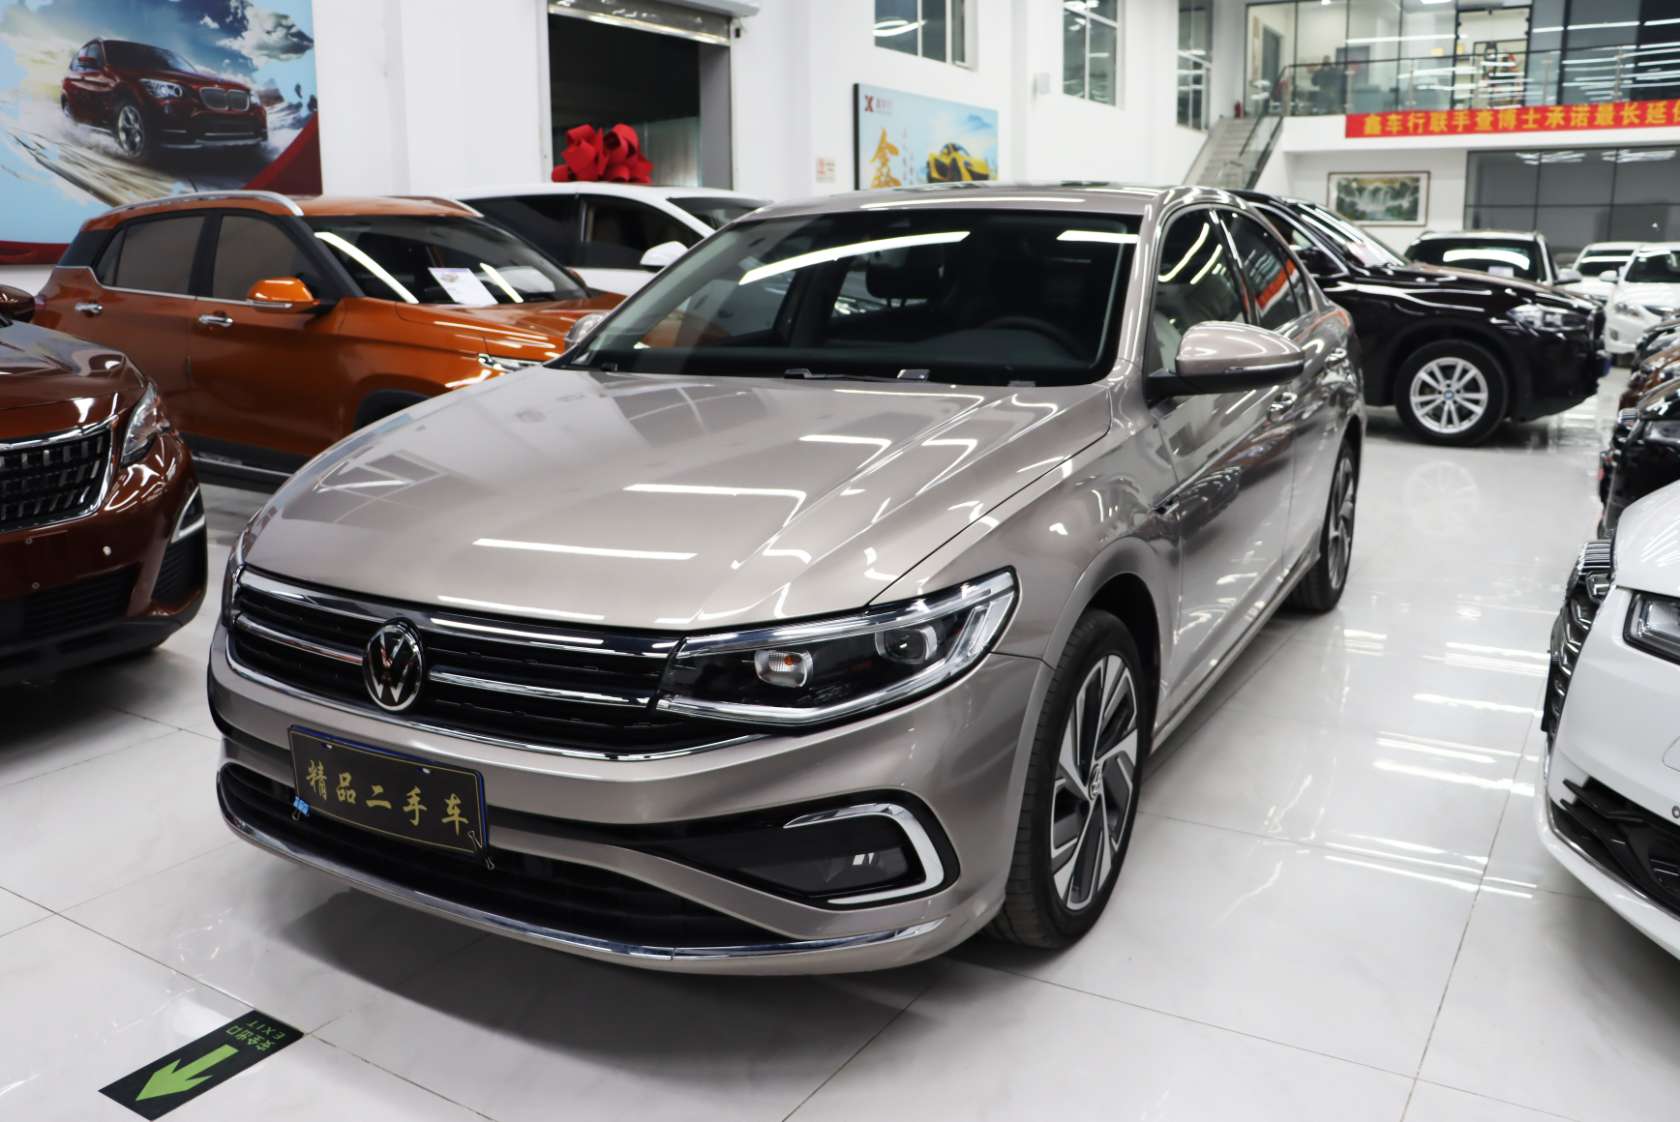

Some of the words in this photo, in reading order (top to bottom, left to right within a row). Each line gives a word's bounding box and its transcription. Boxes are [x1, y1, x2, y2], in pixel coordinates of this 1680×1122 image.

[305, 759, 469, 835] 精品二手车
[247, 1019, 286, 1040] EXIT
